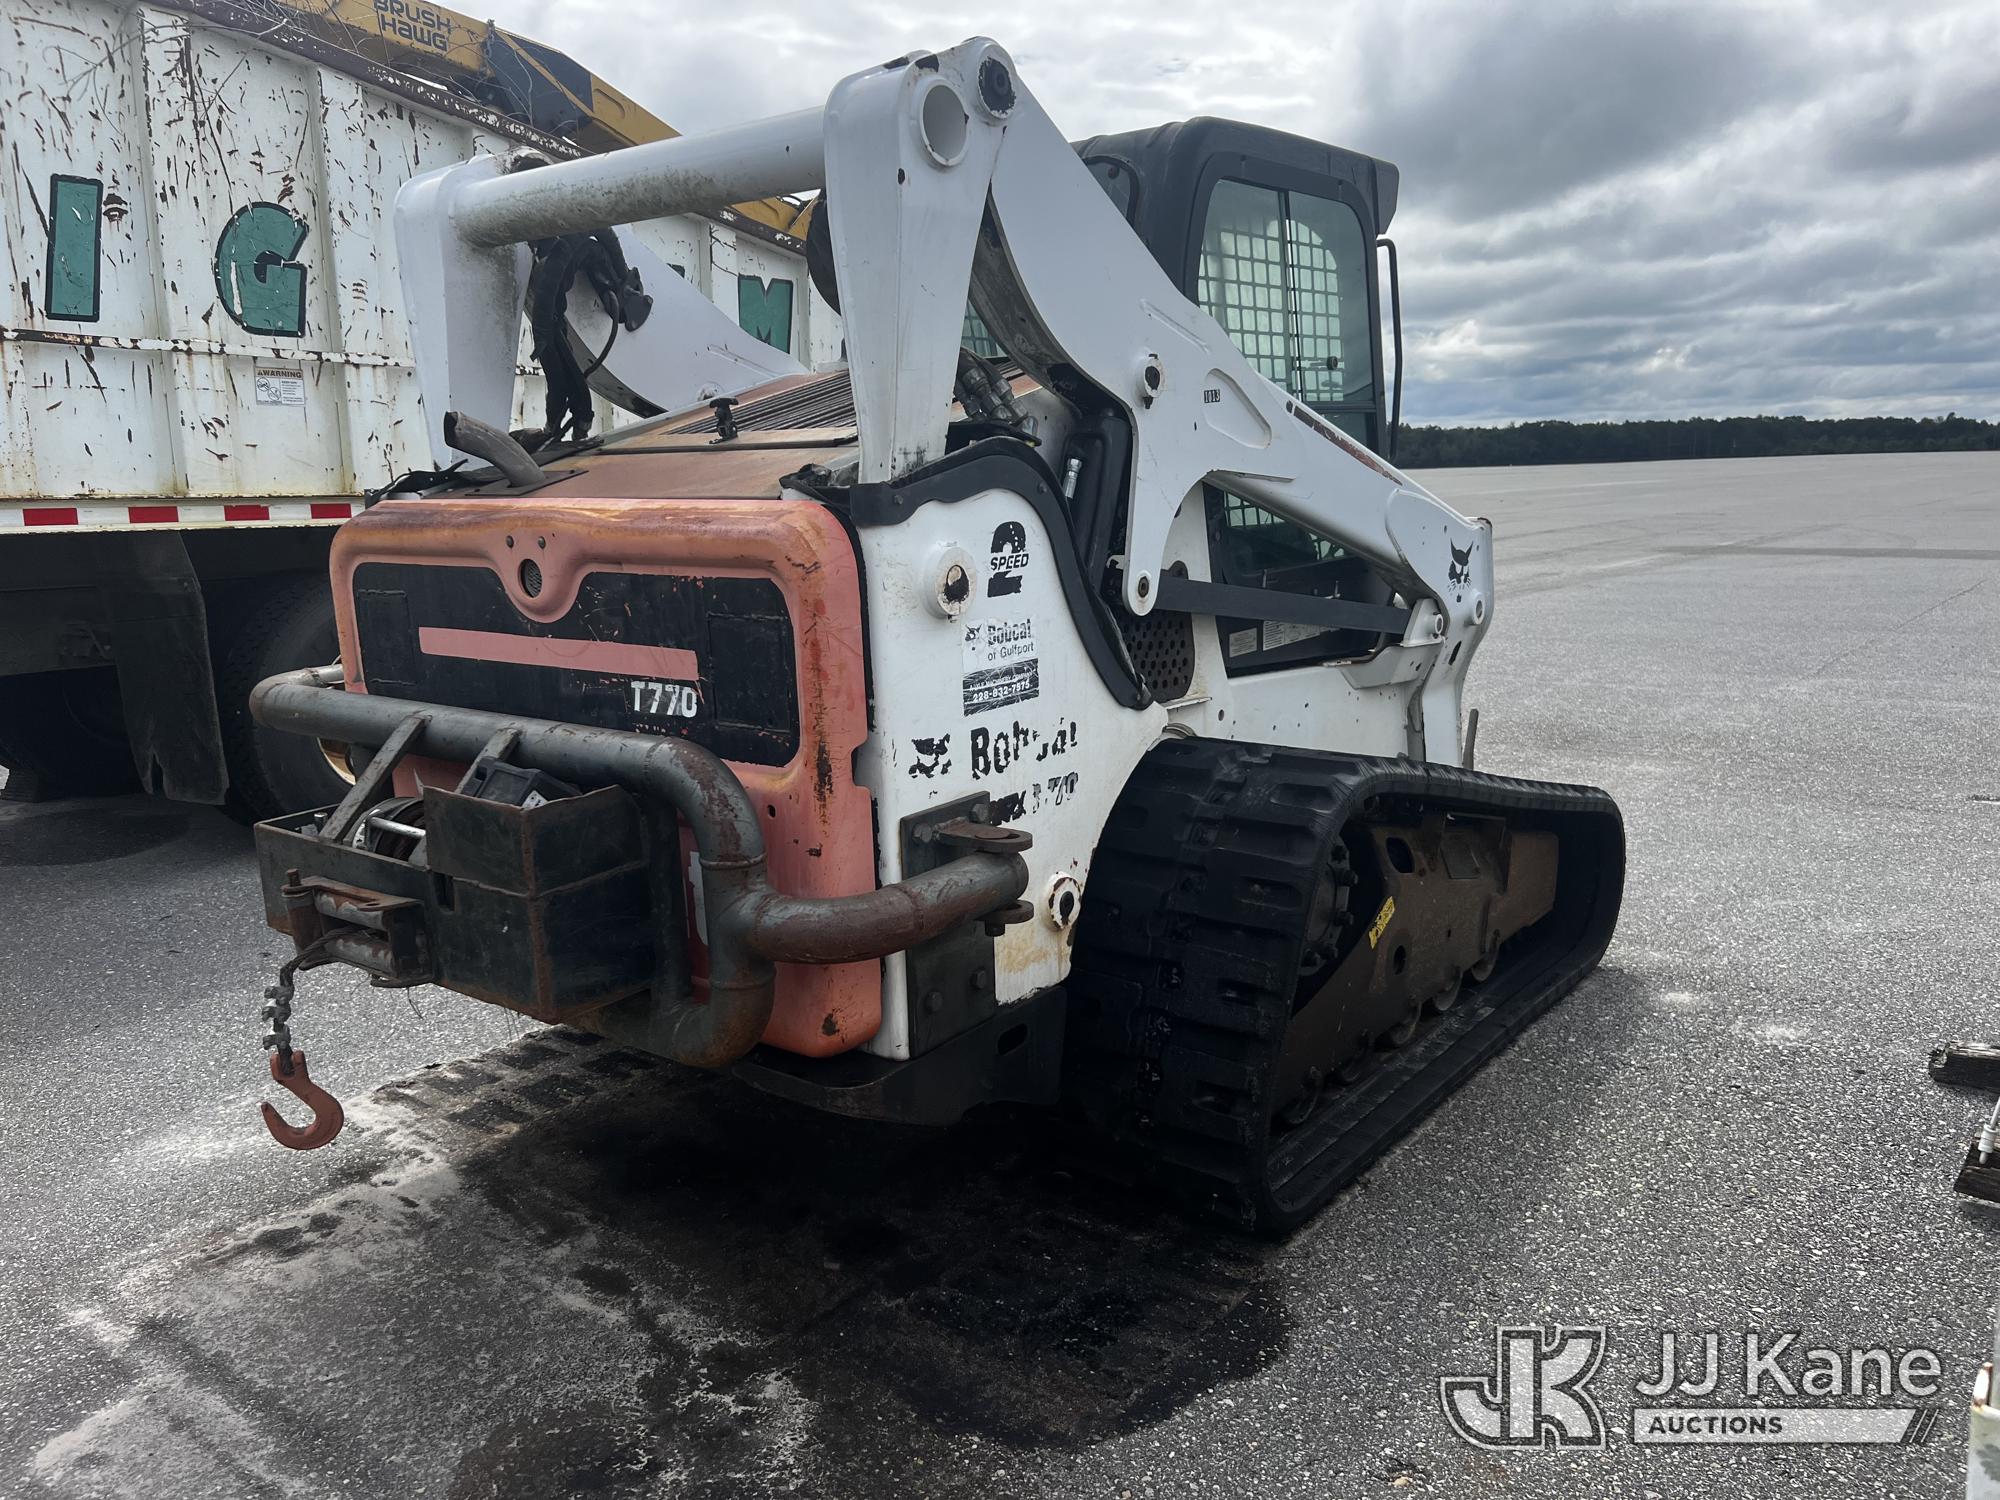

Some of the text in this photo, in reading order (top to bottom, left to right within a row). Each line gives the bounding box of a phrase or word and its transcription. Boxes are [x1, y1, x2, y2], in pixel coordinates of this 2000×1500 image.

[374, 0, 451, 34] BRUSH
[262, 370, 302, 378] WARNING
[991, 553, 1029, 571] SPEED
[987, 618, 1031, 646] Bobcat
[1000, 641, 1034, 658] Gulfport
[630, 681, 698, 718] T770
